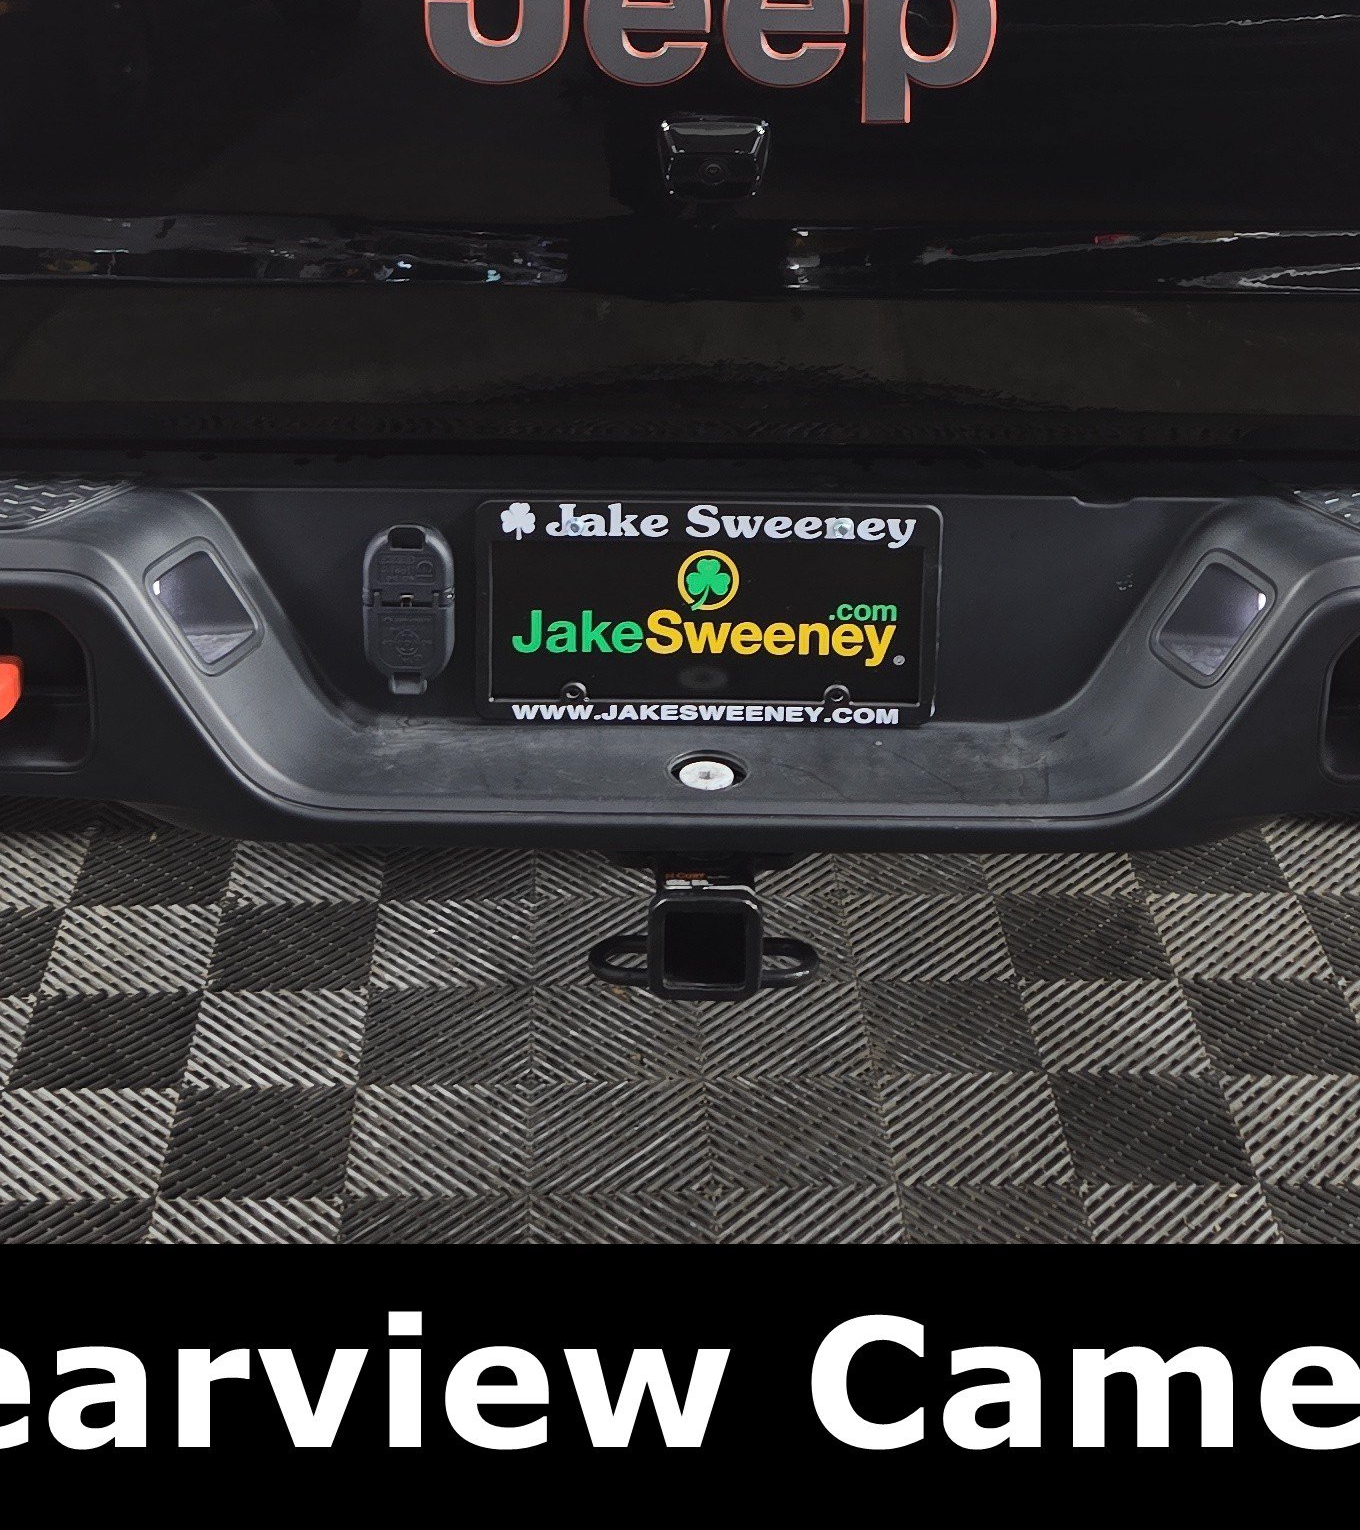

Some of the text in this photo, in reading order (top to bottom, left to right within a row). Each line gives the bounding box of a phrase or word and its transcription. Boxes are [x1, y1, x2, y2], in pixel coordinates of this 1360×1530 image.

[545, 503, 917, 548] Jake Sweeney
[829, 603, 898, 622] .com
[512, 704, 899, 725] WWW.JAKESWEENEY.COM
